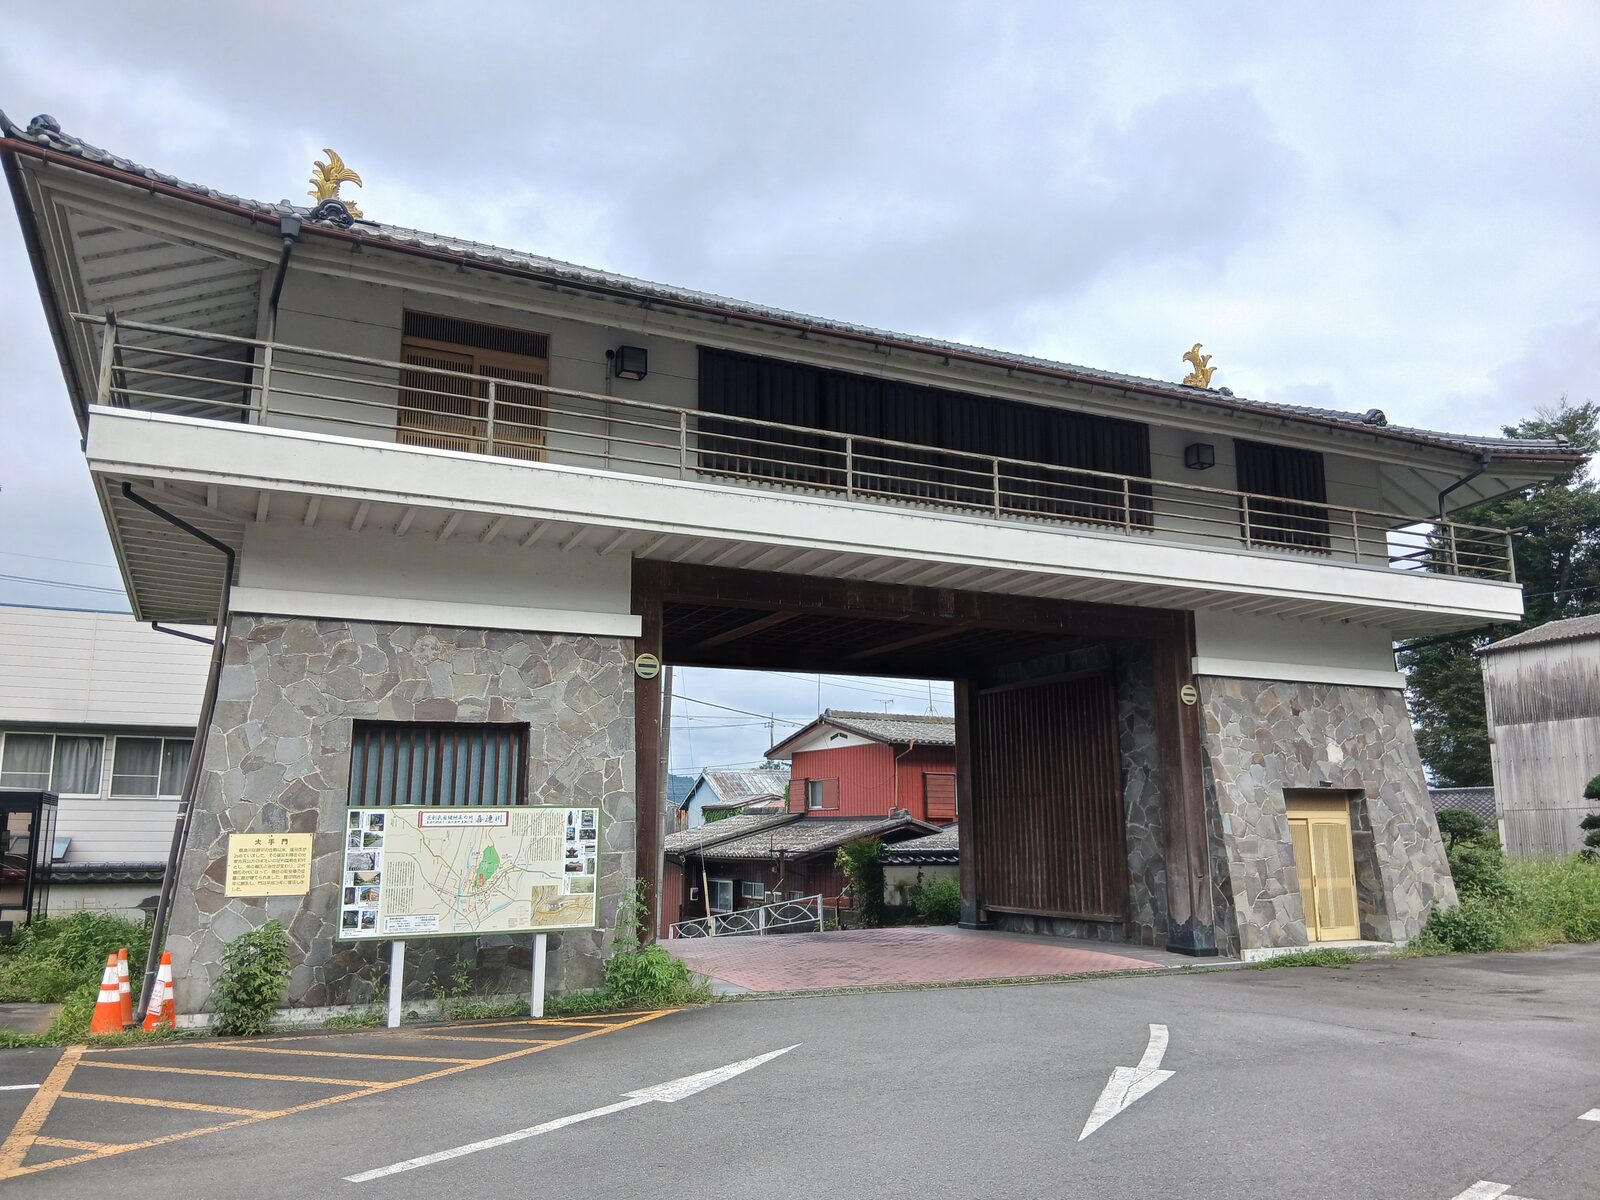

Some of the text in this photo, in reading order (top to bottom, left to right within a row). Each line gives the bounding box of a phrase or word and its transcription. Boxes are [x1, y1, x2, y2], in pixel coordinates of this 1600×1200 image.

[476, 814, 502, 823] 喜連川
[254, 838, 289, 846] 大手門
